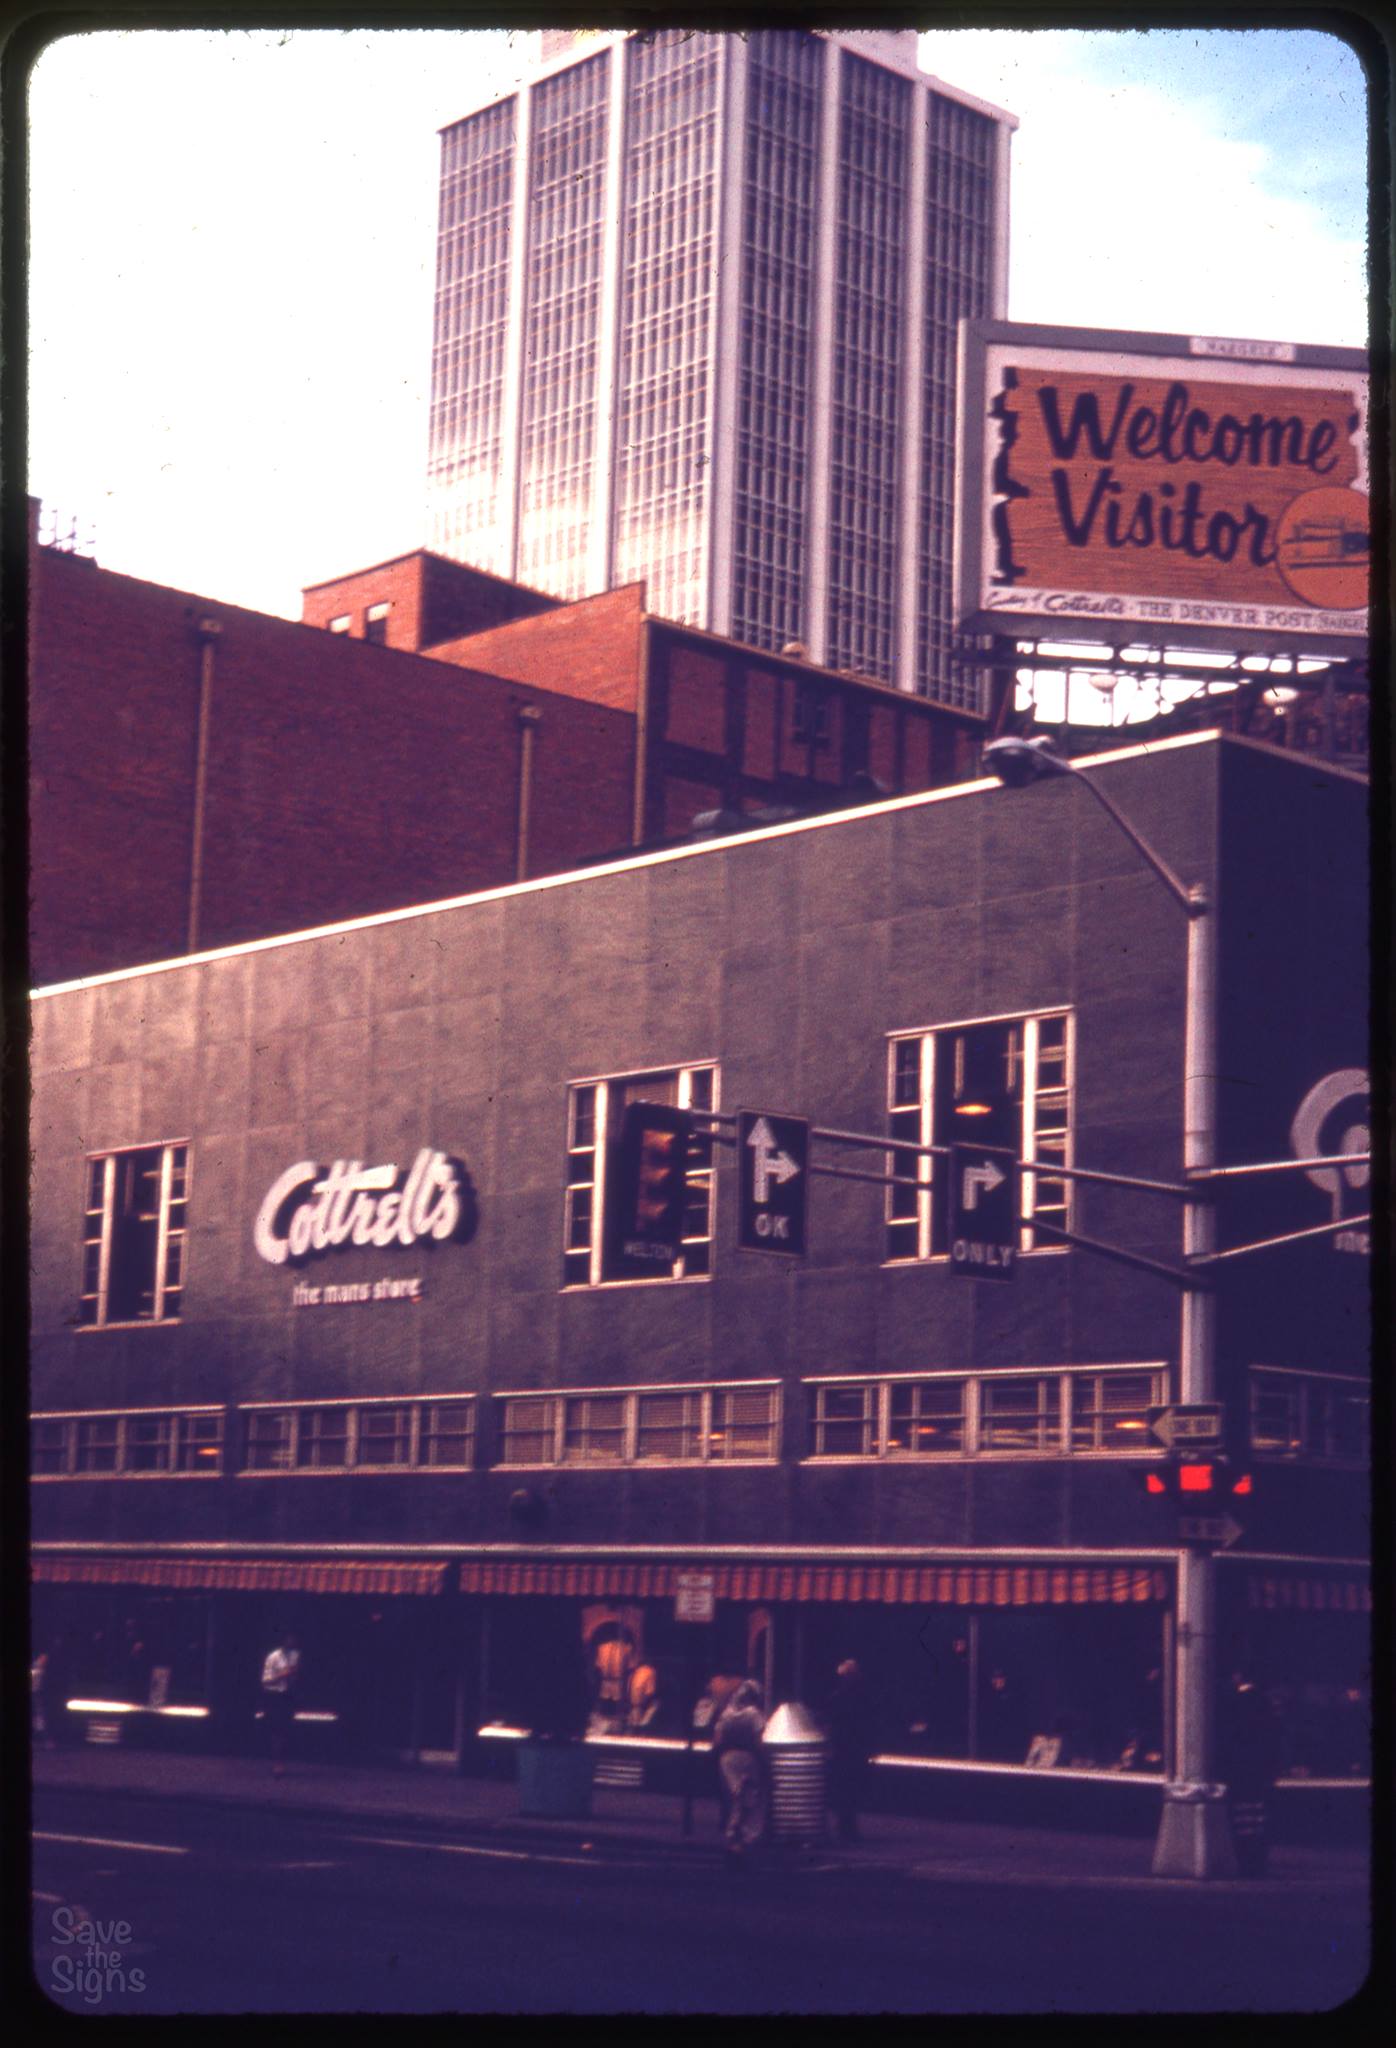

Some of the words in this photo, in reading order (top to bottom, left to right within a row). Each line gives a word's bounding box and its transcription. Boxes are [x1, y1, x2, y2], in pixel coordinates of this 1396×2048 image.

[1037, 381, 1339, 474] Welcome
[1051, 466, 1278, 567] Visitor
[1137, 601, 1172, 618] THE
[1180, 604, 1257, 624] DENVER
[1265, 610, 1314, 628] POST
[755, 1213, 789, 1239] OK
[953, 1238, 1015, 1267] ONLY
